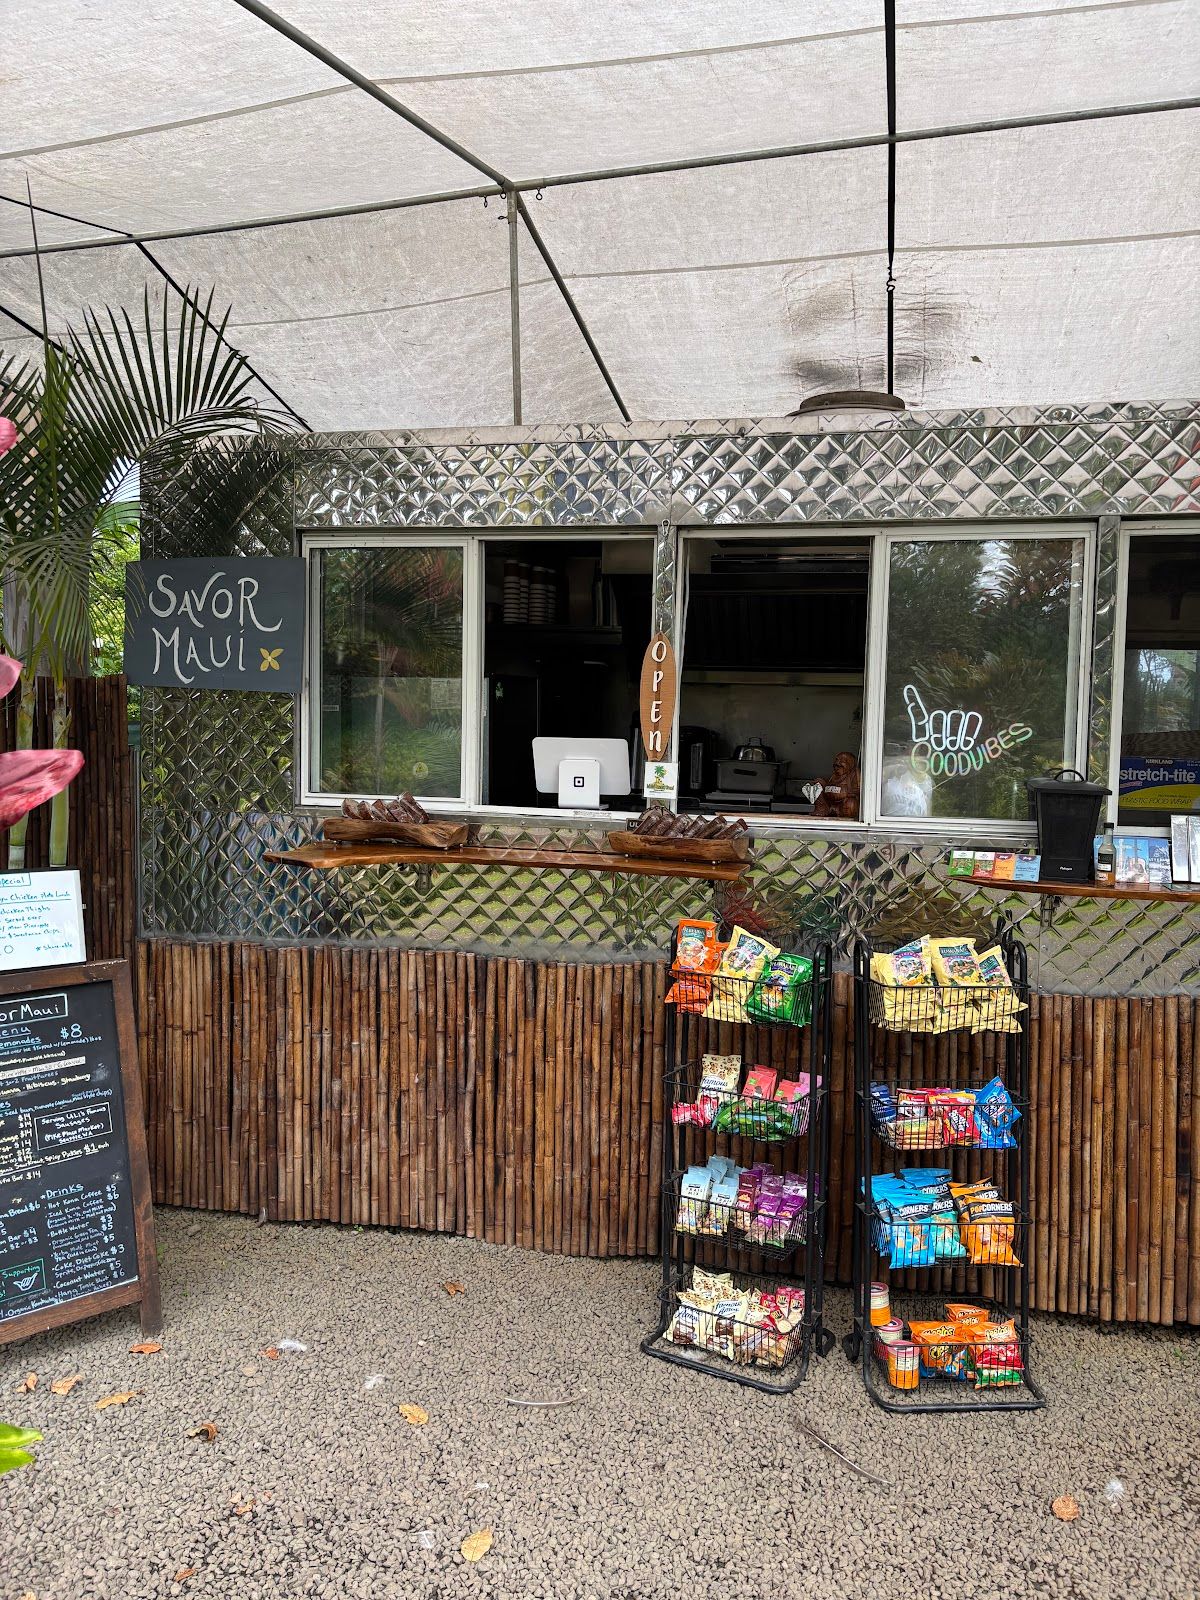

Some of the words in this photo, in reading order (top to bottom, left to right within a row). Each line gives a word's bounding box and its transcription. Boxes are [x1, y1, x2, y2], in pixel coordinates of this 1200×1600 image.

[148, 571, 283, 632] SAVOR
[20, 1003, 59, 1020] Maui
[0, 1036, 41, 1049] emonades
[60, 1023, 82, 1040] $8
[1, 1025, 31, 1037] enu
[105, 1183, 117, 1193] $5
[107, 1190, 120, 1201] $6
[103, 1232, 115, 1243] $5
[110, 1243, 124, 1255] $3
[83, 1269, 106, 1280] Water
